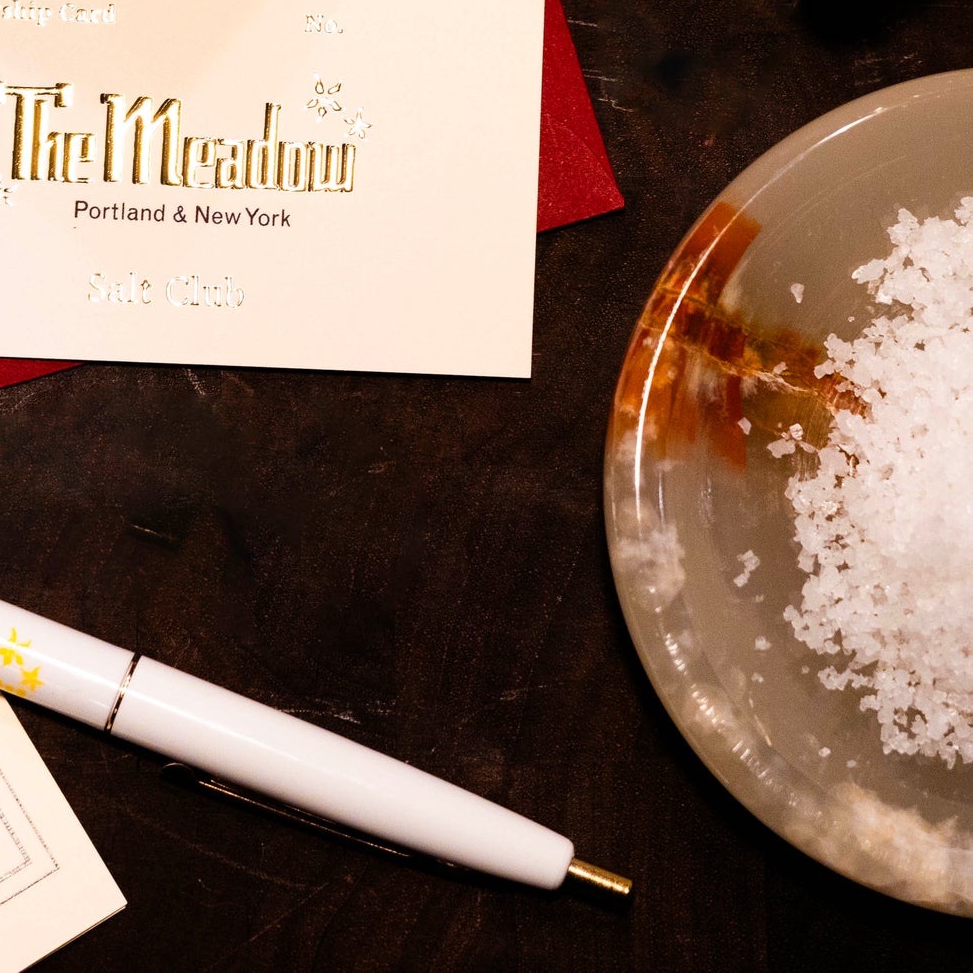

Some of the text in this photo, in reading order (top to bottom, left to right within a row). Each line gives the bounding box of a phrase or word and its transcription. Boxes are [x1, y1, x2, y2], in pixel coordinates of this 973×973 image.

[59, 3, 117, 25] Card
[304, 14, 343, 34] No.
[100, 93, 356, 194] Meadow
[75, 200, 290, 227] Portland & New York
[87, 272, 244, 309] Salt Club
